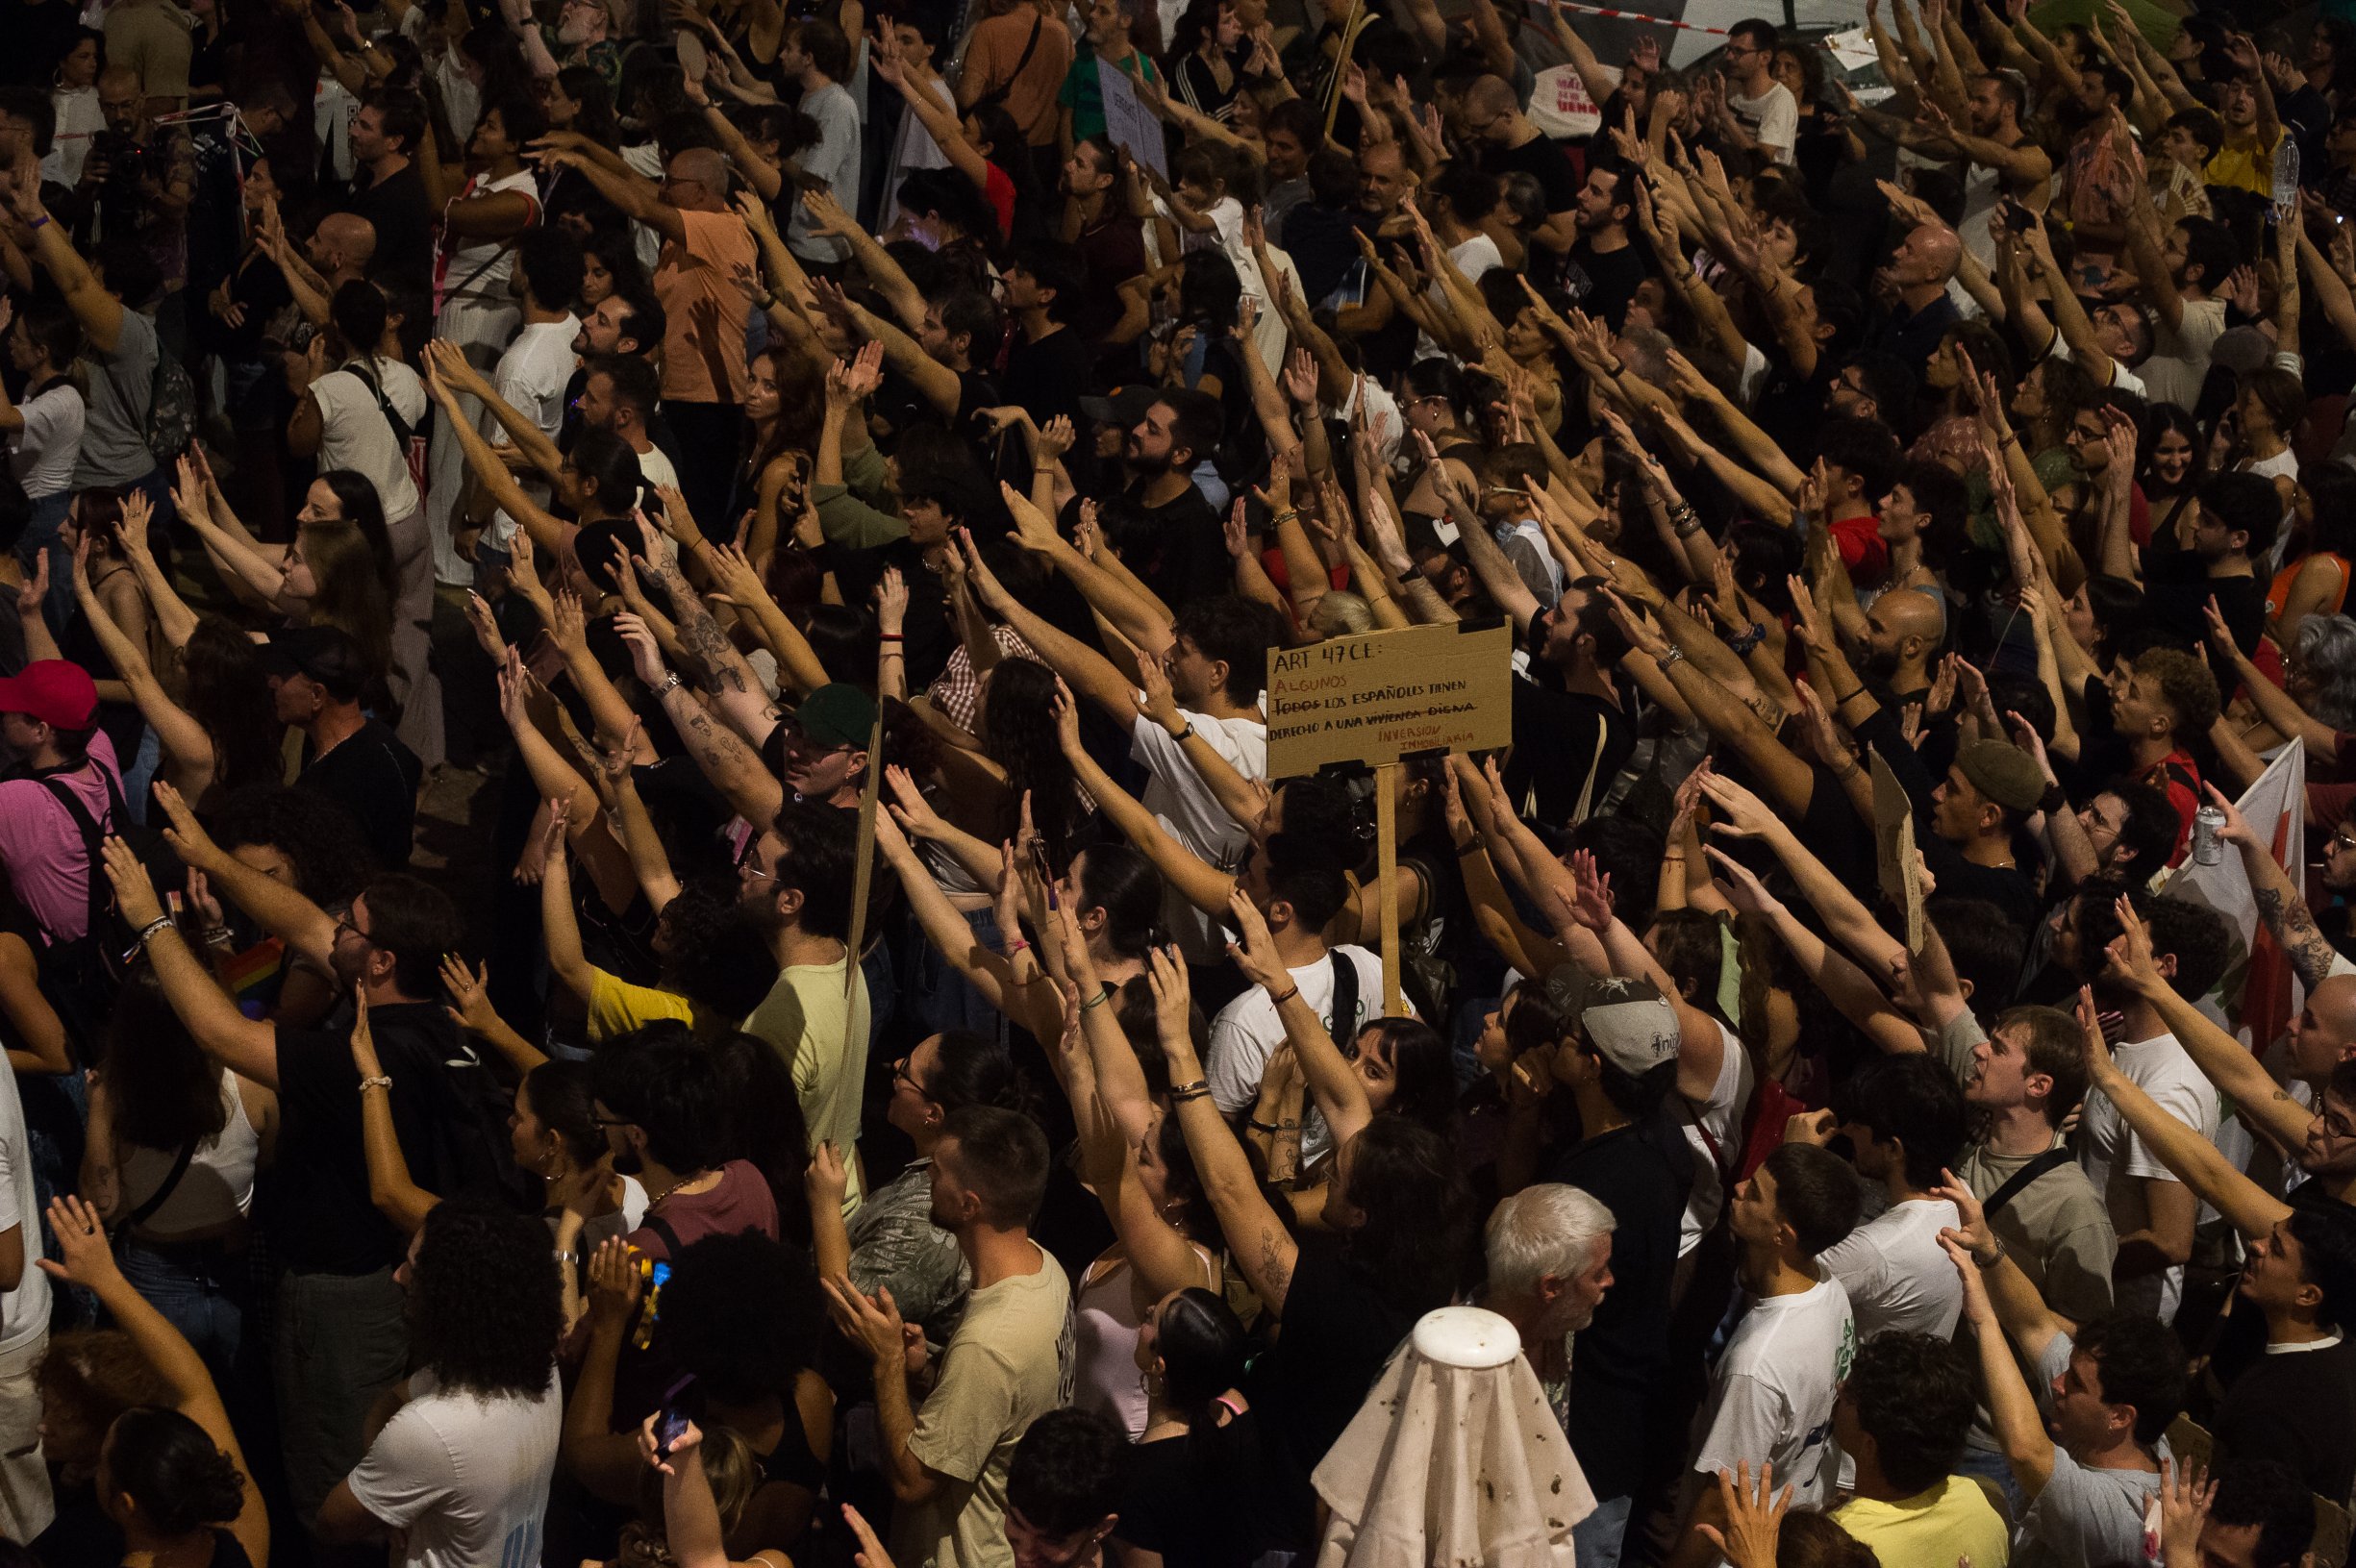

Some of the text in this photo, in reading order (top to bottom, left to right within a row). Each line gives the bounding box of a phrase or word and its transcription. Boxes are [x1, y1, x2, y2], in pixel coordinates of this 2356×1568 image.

[1274, 651, 1311, 674] ART
[1323, 646, 1344, 664] 47
[1274, 675, 1347, 694] ALGUNOS
[1324, 697, 1346, 709] LOS
[1353, 684, 1424, 705] ESPAÑOLES
[1429, 680, 1466, 695] TIENEN
[1269, 722, 1318, 741] DERECHO
[1324, 719, 1334, 731] A
[1337, 717, 1363, 730] UNA
[1366, 709, 1421, 726] VIVIENDA
